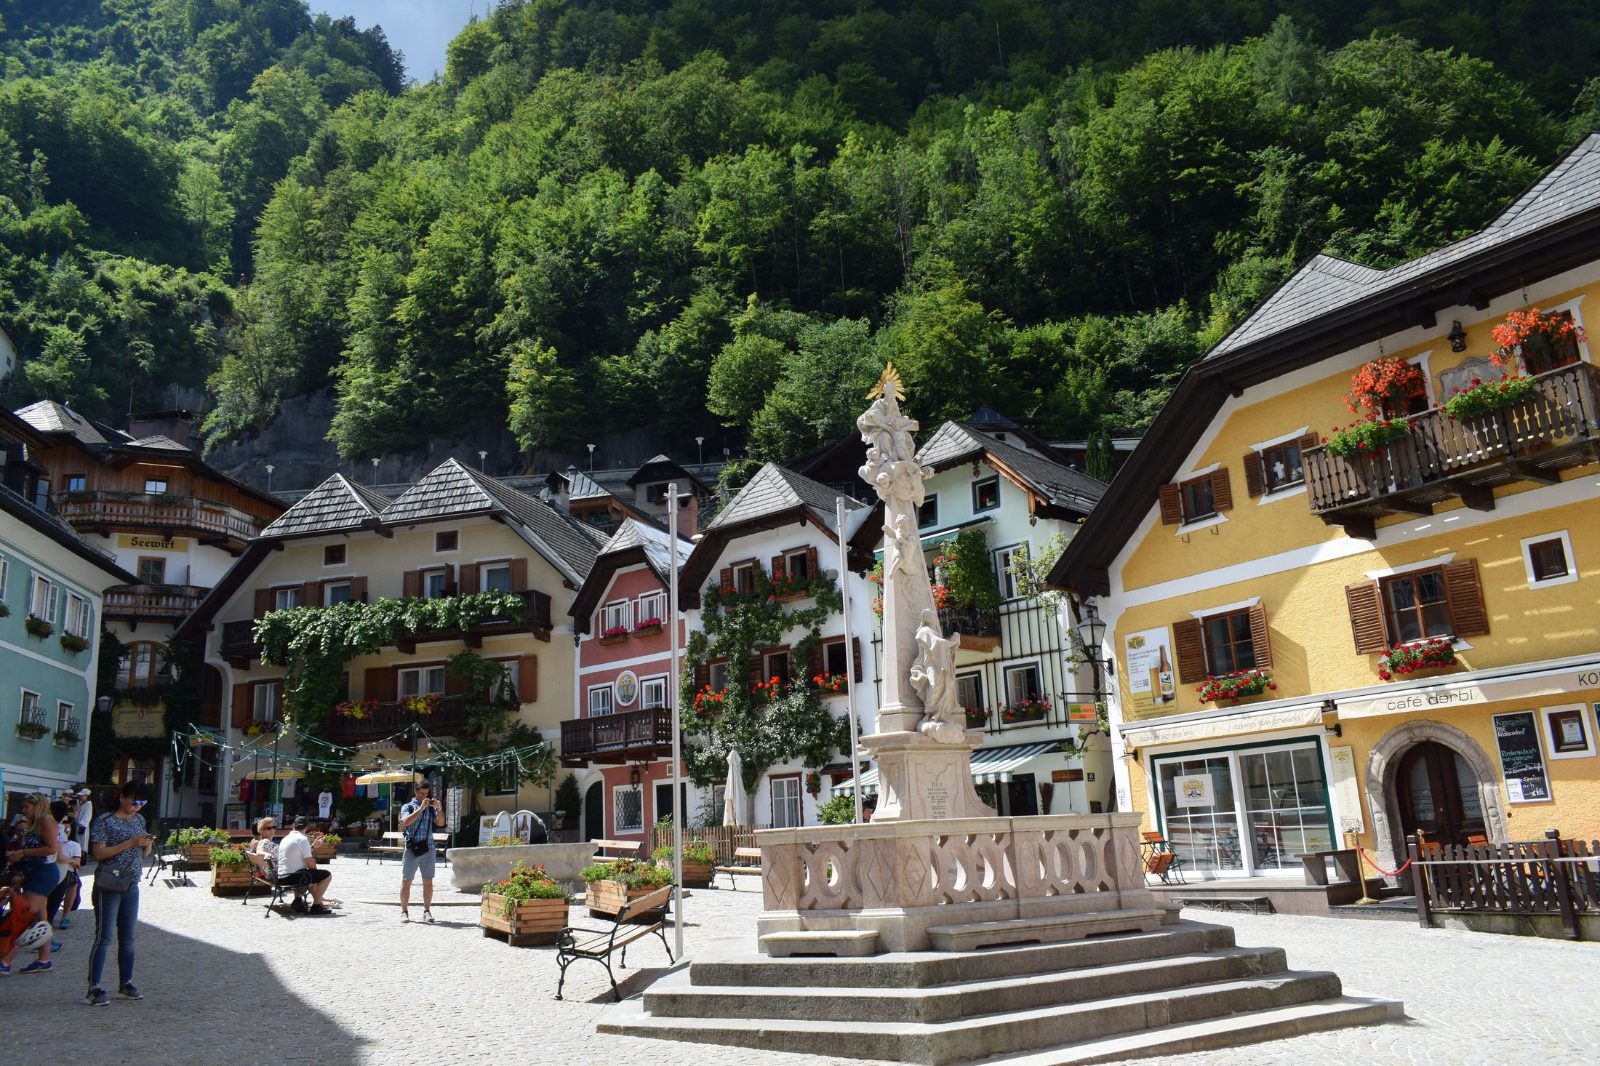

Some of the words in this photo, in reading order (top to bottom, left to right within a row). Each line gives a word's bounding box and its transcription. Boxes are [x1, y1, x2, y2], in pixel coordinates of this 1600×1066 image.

[131, 536, 175, 549] Seewirt
[1387, 696, 1422, 711] café
[1427, 689, 1473, 706] derbl
